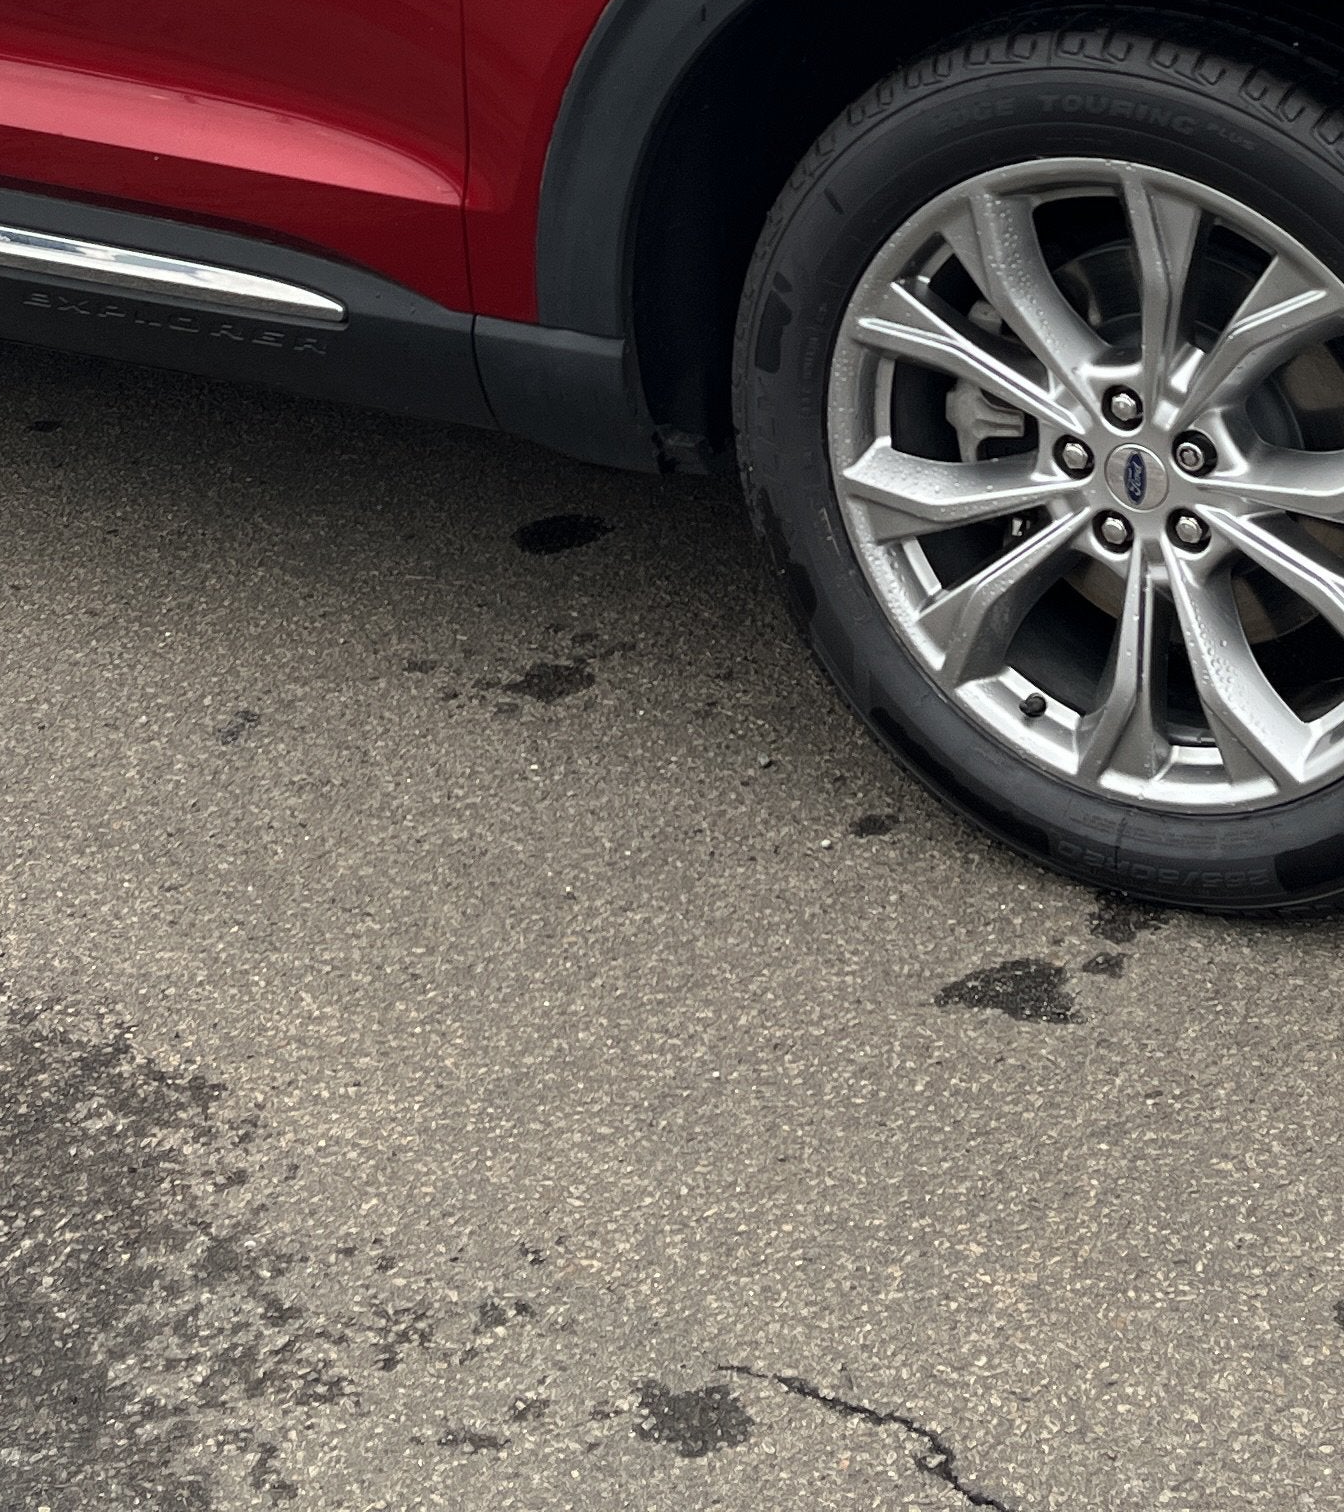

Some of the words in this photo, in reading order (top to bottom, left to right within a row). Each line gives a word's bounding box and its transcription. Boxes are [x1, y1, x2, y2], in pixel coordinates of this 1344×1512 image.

[1039, 93, 1196, 137] TOURING
[22, 291, 327, 356] EXPLORER
[1127, 460, 1142, 497] Ford
